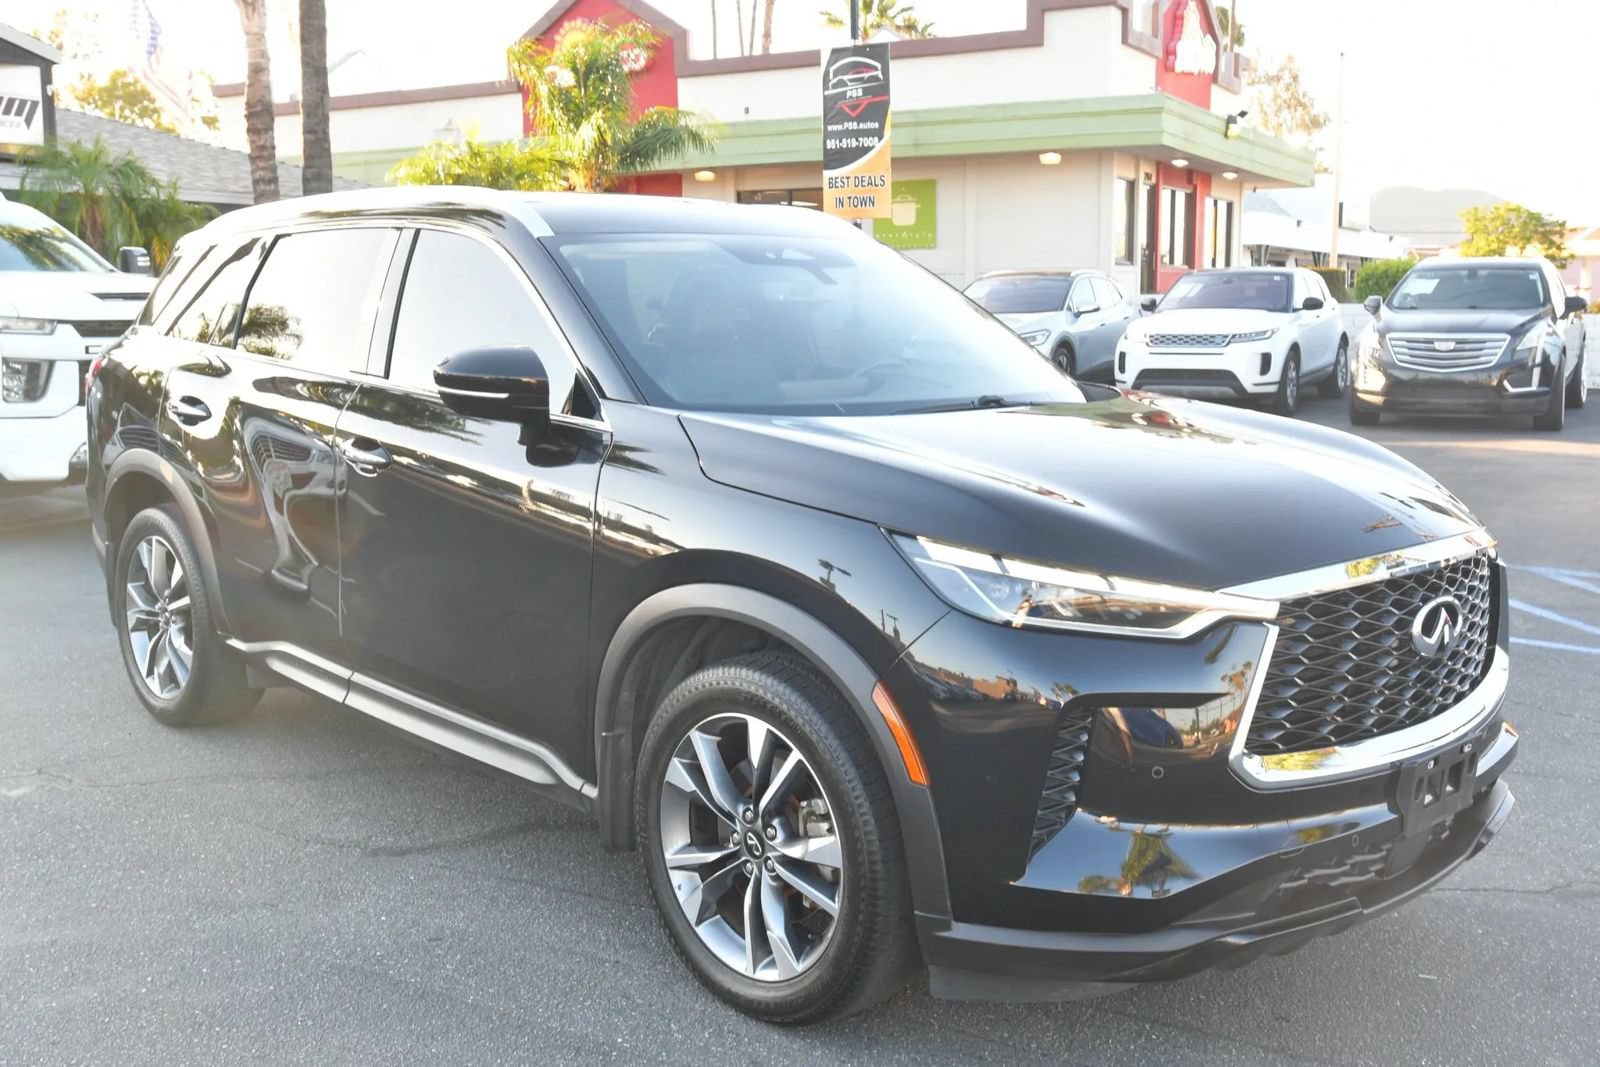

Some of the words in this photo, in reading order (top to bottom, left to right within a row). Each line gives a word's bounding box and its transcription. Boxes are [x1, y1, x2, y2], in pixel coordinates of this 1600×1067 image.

[846, 88, 863, 99] PSS
[827, 121, 879, 131] www.PSS.autos
[828, 176, 851, 189] BEST
[854, 175, 886, 188] DEALS
[835, 196, 845, 209] IN
[847, 195, 876, 208] TOWN
